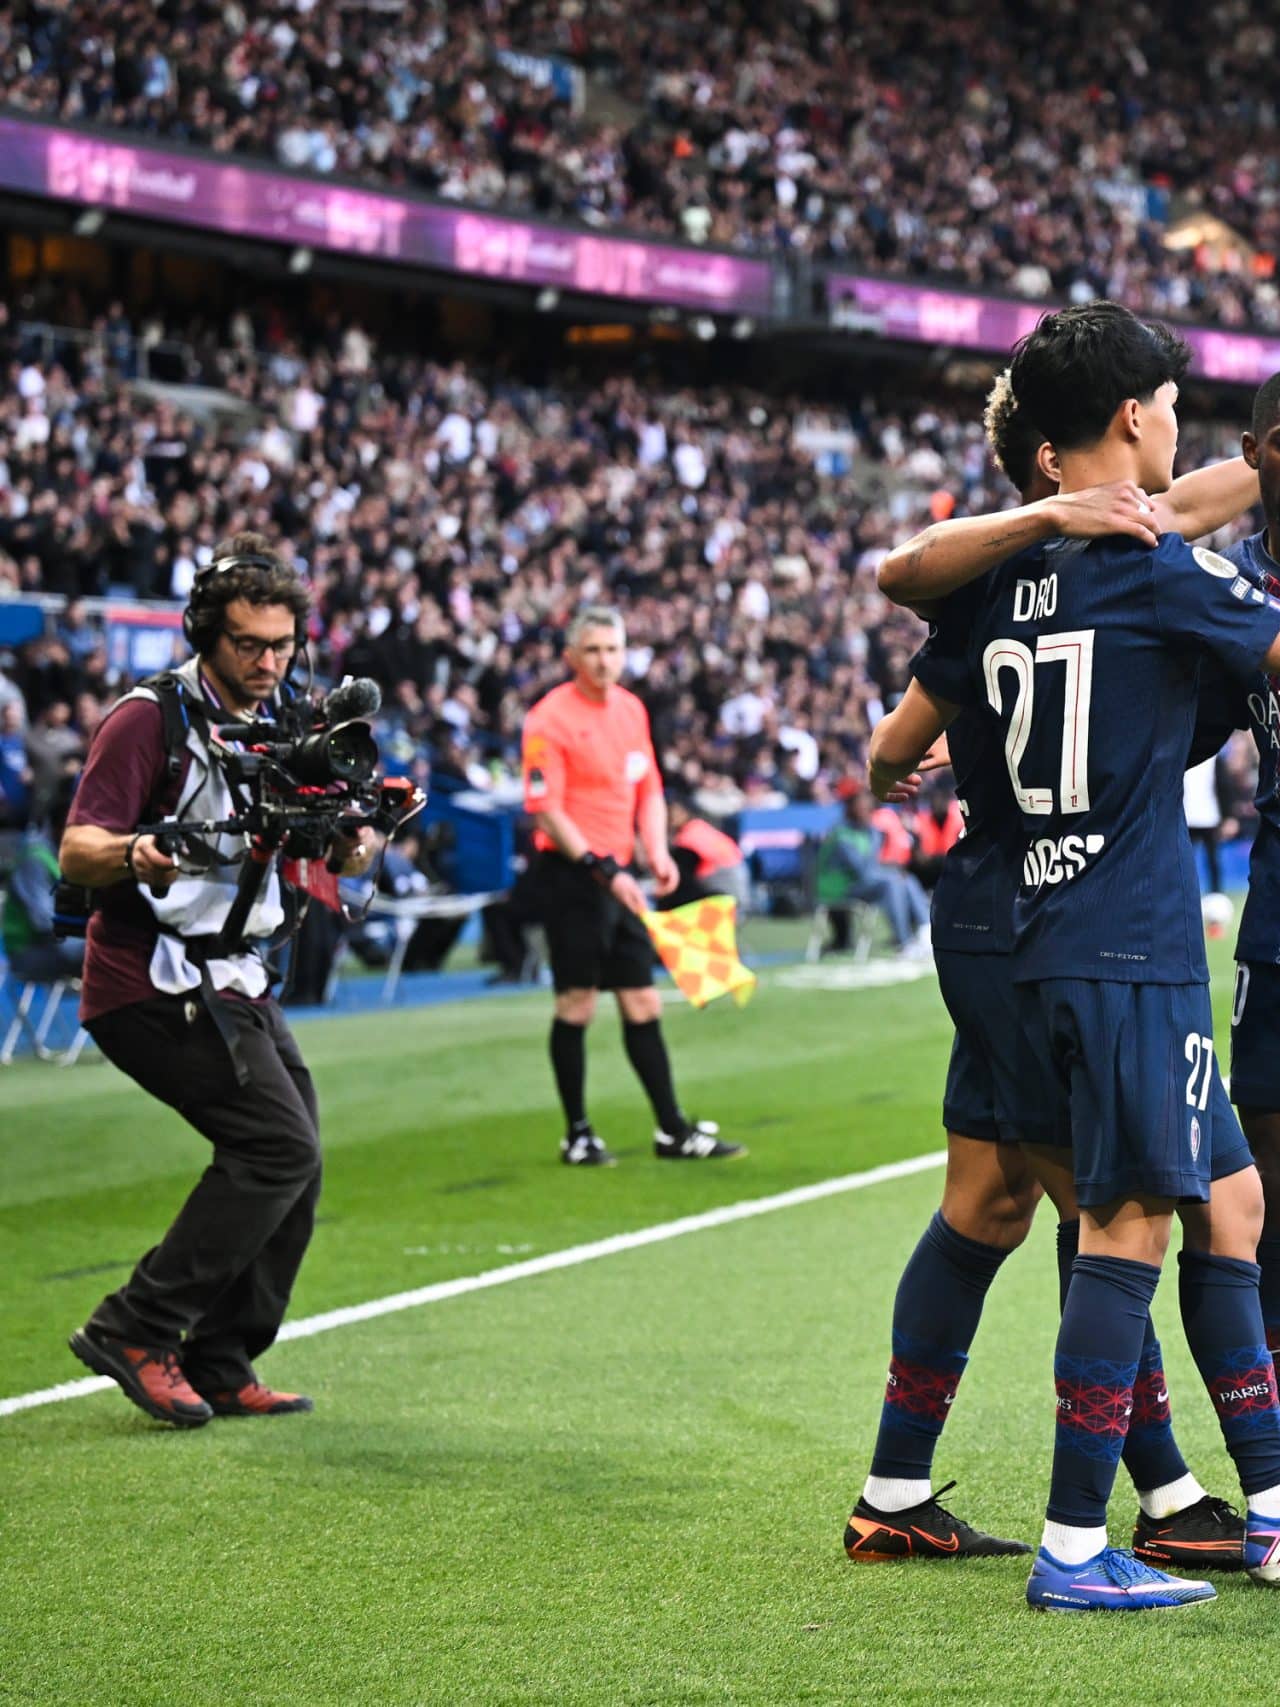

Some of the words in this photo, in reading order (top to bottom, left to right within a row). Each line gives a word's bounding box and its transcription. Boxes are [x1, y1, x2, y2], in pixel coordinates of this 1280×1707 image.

[1013, 573, 1058, 622] DRO
[983, 629, 1096, 815] 27
[1185, 1032, 1214, 1112] 27
[1220, 1382, 1269, 1403] PARIS
